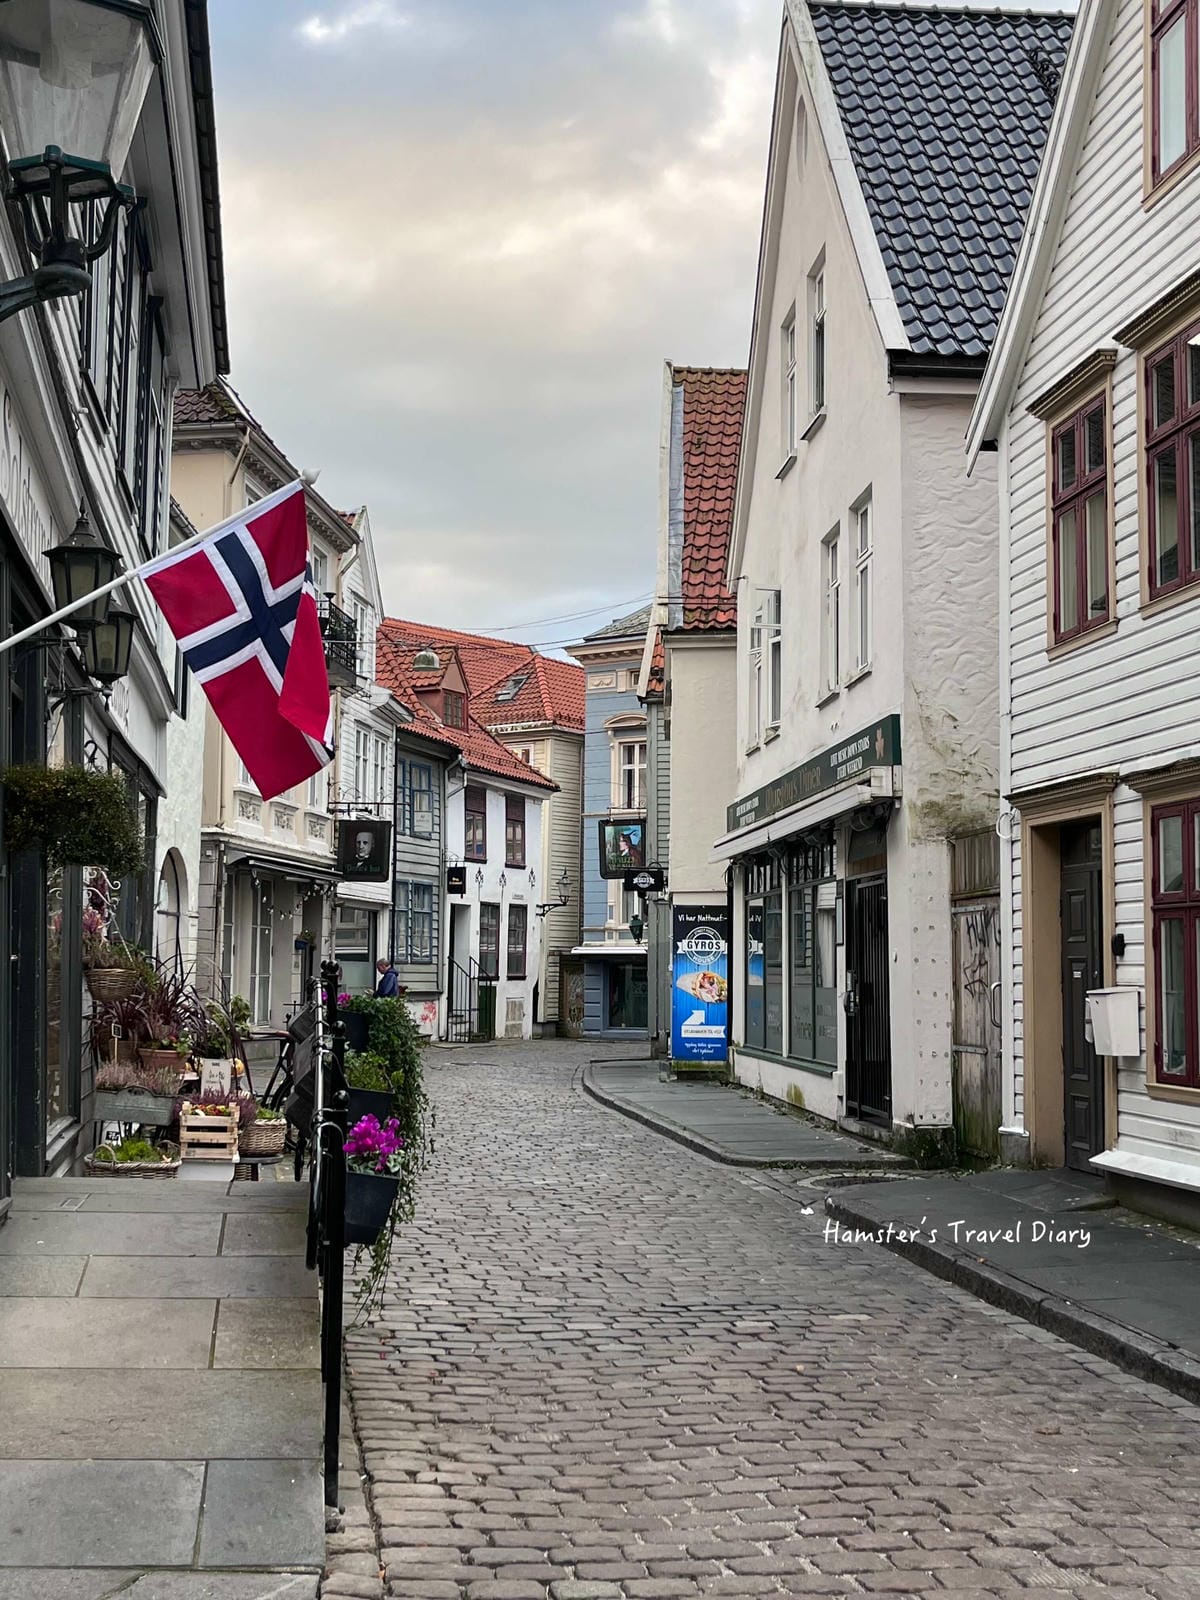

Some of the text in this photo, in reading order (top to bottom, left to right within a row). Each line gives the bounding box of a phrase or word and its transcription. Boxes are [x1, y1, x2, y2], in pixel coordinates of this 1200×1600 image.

[678, 914, 685, 922] Vi
[685, 914, 696, 922] har
[687, 940, 721, 950] GYROS
[692, 955, 716, 964] HOUSE
